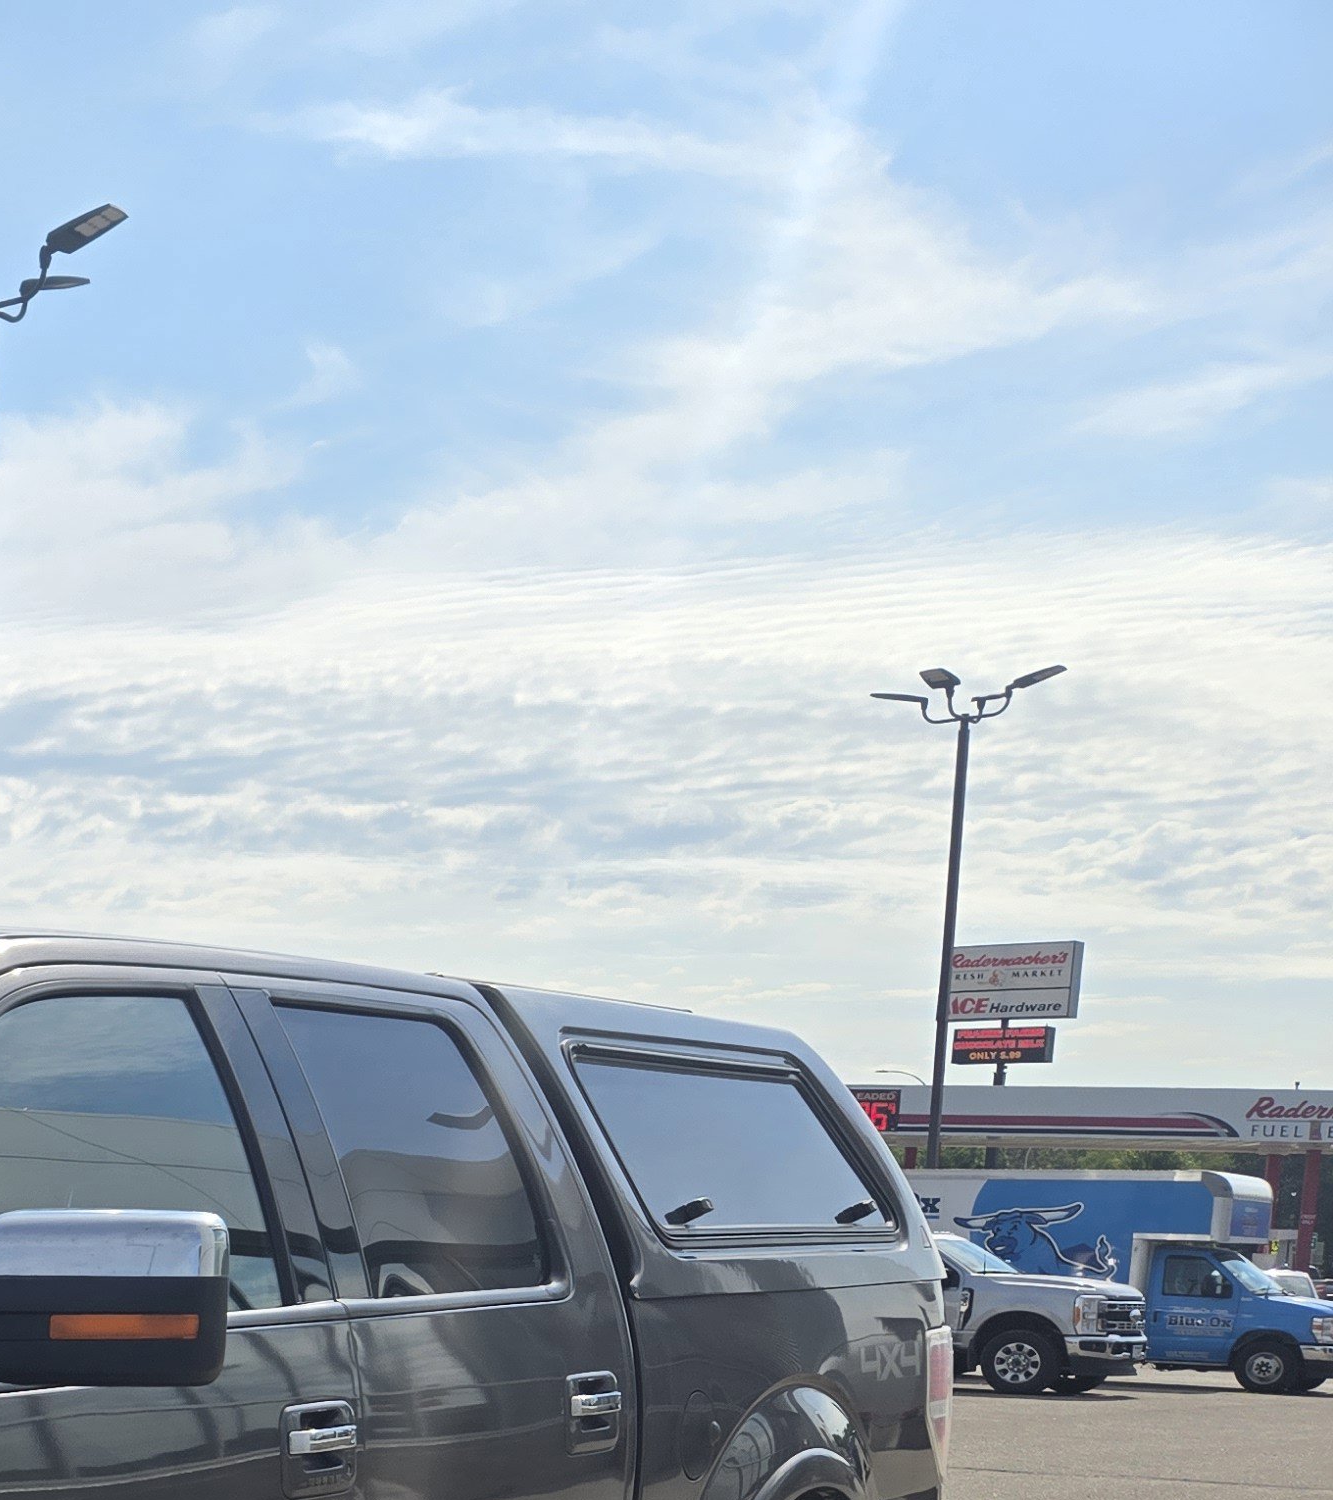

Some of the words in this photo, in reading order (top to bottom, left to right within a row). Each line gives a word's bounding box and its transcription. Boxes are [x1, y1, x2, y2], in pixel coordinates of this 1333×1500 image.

[1012, 969, 1063, 978] MARKET
[989, 1001, 1063, 1014] Hardware
[969, 1051, 997, 1060] ONLY
[856, 1091, 896, 1101] EADED
[1250, 1124, 1304, 1138] FUEL
[1210, 1316, 1232, 1328] Ox
[859, 1337, 921, 1381] 4X4
